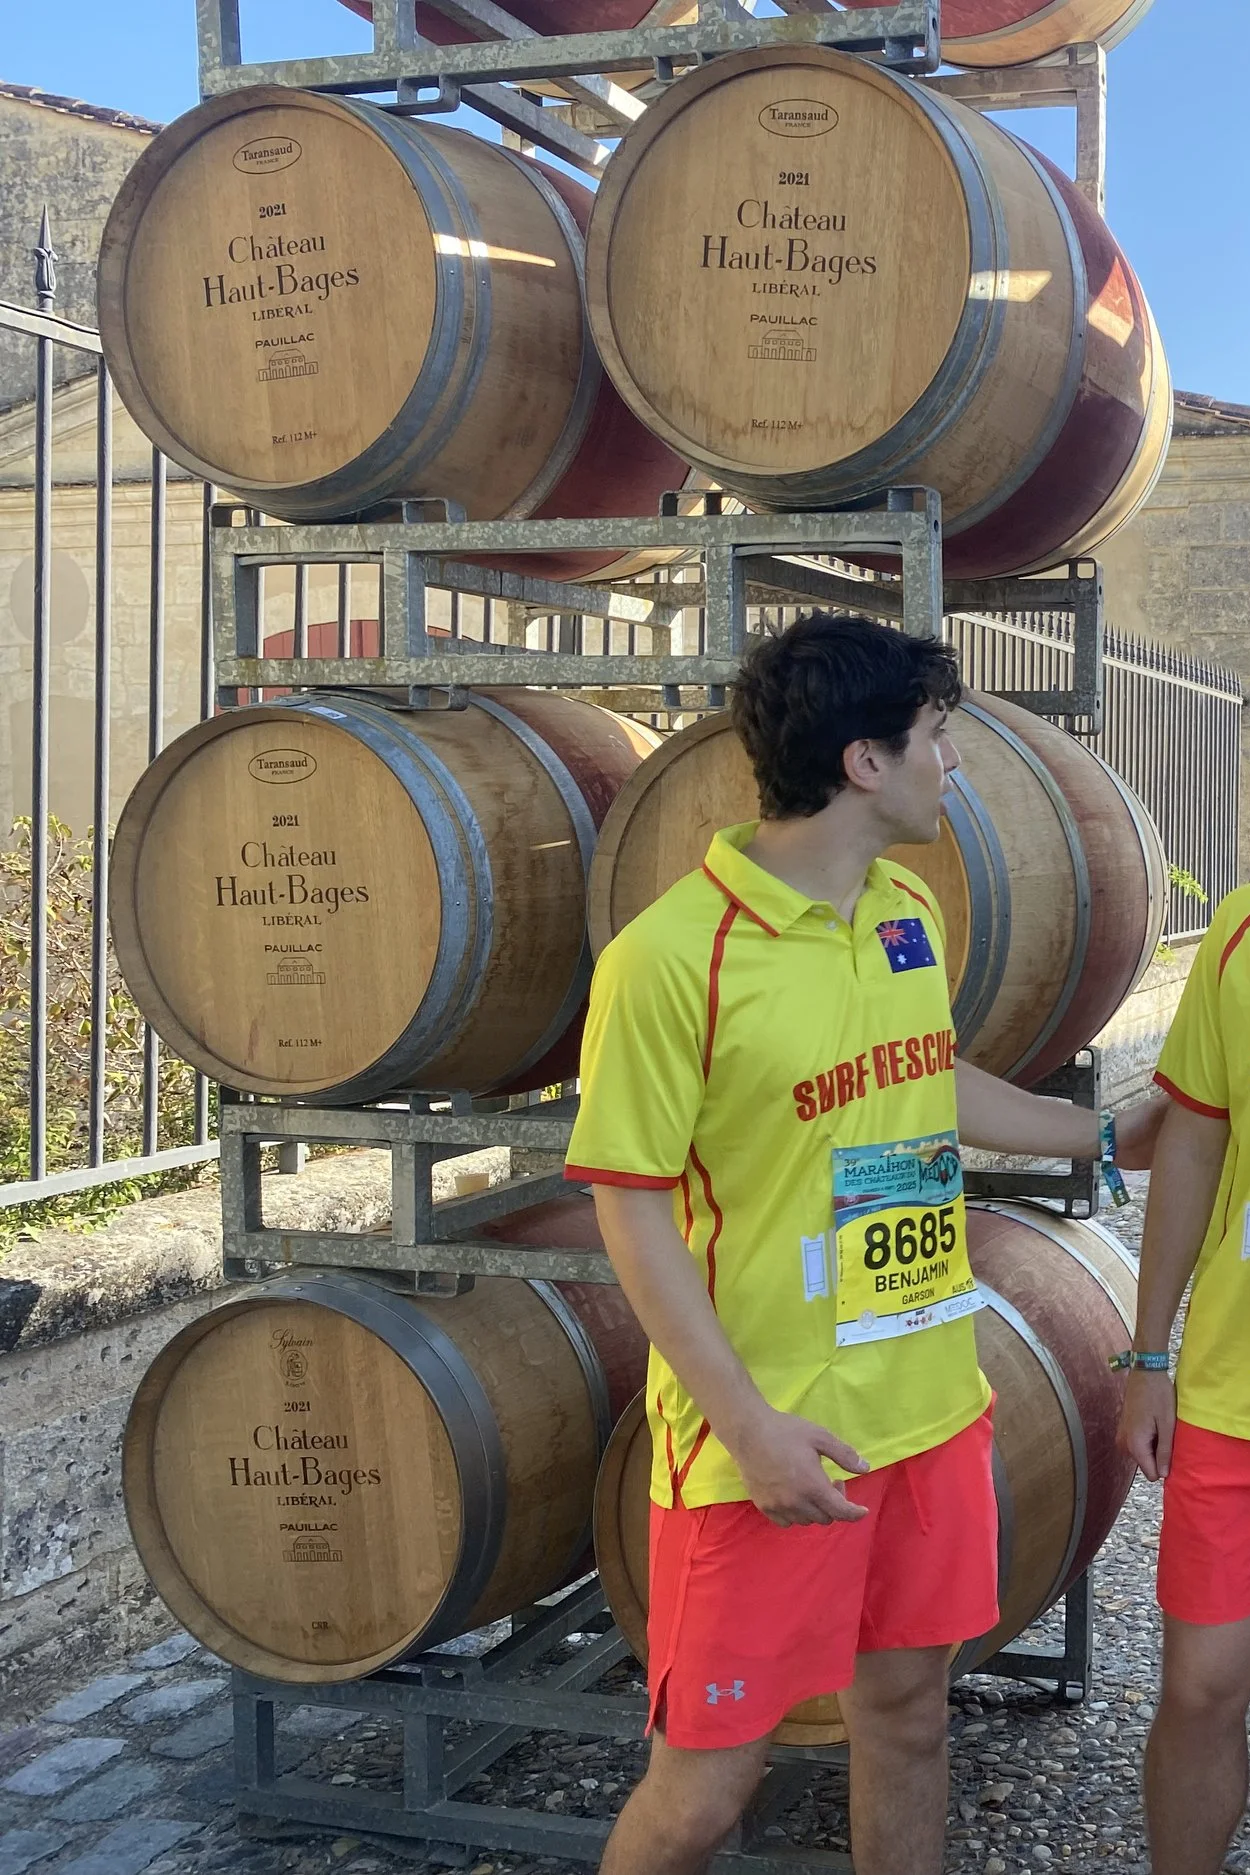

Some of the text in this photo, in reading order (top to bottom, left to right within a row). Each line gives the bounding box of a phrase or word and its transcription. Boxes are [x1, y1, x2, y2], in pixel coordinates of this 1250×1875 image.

[769, 108, 829, 121] Taransaud
[242, 143, 293, 161] Taransaud
[778, 172, 810, 186] 2021
[259, 203, 287, 218] 2021
[737, 199, 846, 232] Château
[228, 235, 325, 263] Château
[700, 235, 877, 285] Haut-Bages
[203, 264, 360, 307] Haut-Bages
[752, 279, 820, 297] LIBÉRAL
[252, 304, 313, 321] LIBÉRAL
[750, 314, 818, 326] PAUILLAC
[255, 333, 315, 349] PAUILLAC
[256, 757, 308, 769] Taransaud
[272, 814, 300, 827] 2021
[241, 841, 337, 868] Château
[215, 874, 369, 914] Haut-Bages
[262, 912, 322, 928] LIBÉRAL
[264, 944, 323, 953] PAUILLAC
[793, 1029, 959, 1122] SURF RESCUE
[844, 1154, 916, 1178] MARATHON
[845, 1178, 863, 1187] DES
[896, 1181, 917, 1192] 2025
[864, 1207, 956, 1270] 8685
[875, 1259, 949, 1293] BENJAMIN
[952, 1281, 966, 1294] AUS
[902, 1288, 935, 1305] GARSON
[269, 1328, 314, 1353] Sylvain
[284, 1401, 312, 1412] 2021
[253, 1424, 349, 1451] Château
[228, 1456, 382, 1495] Haut-Bages
[276, 1493, 337, 1508] LIBÉRAL
[279, 1523, 339, 1532] PAUILLAC
